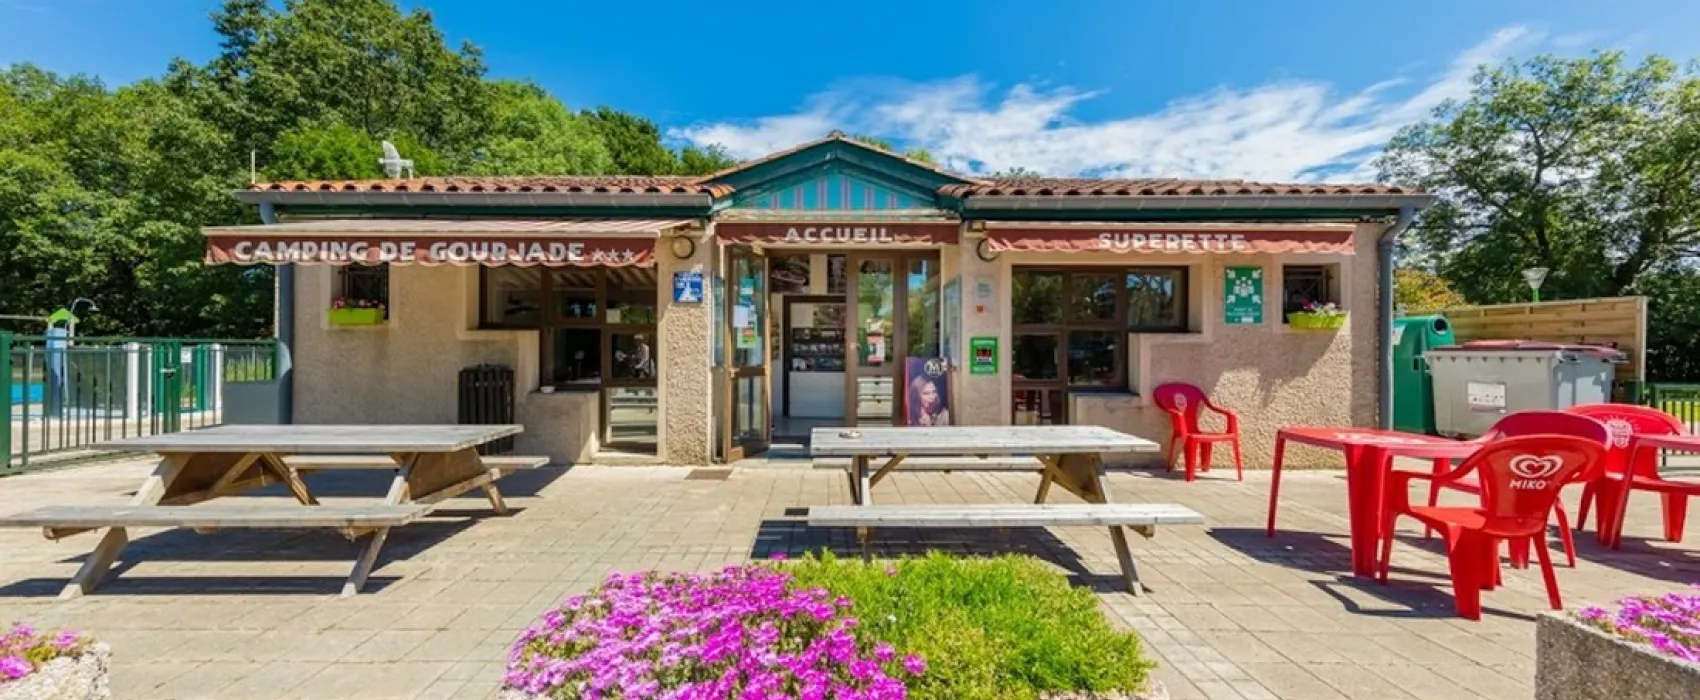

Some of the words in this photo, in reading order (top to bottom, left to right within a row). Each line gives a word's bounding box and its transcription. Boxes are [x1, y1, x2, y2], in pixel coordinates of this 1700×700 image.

[785, 226, 892, 242] ACCUEIL
[1098, 233, 1246, 250] SUPERETTE
[235, 240, 369, 261] CAMPING
[379, 241, 416, 261] DE
[430, 242, 585, 261] GOURJADE
[1509, 479, 1546, 490] MIKO
